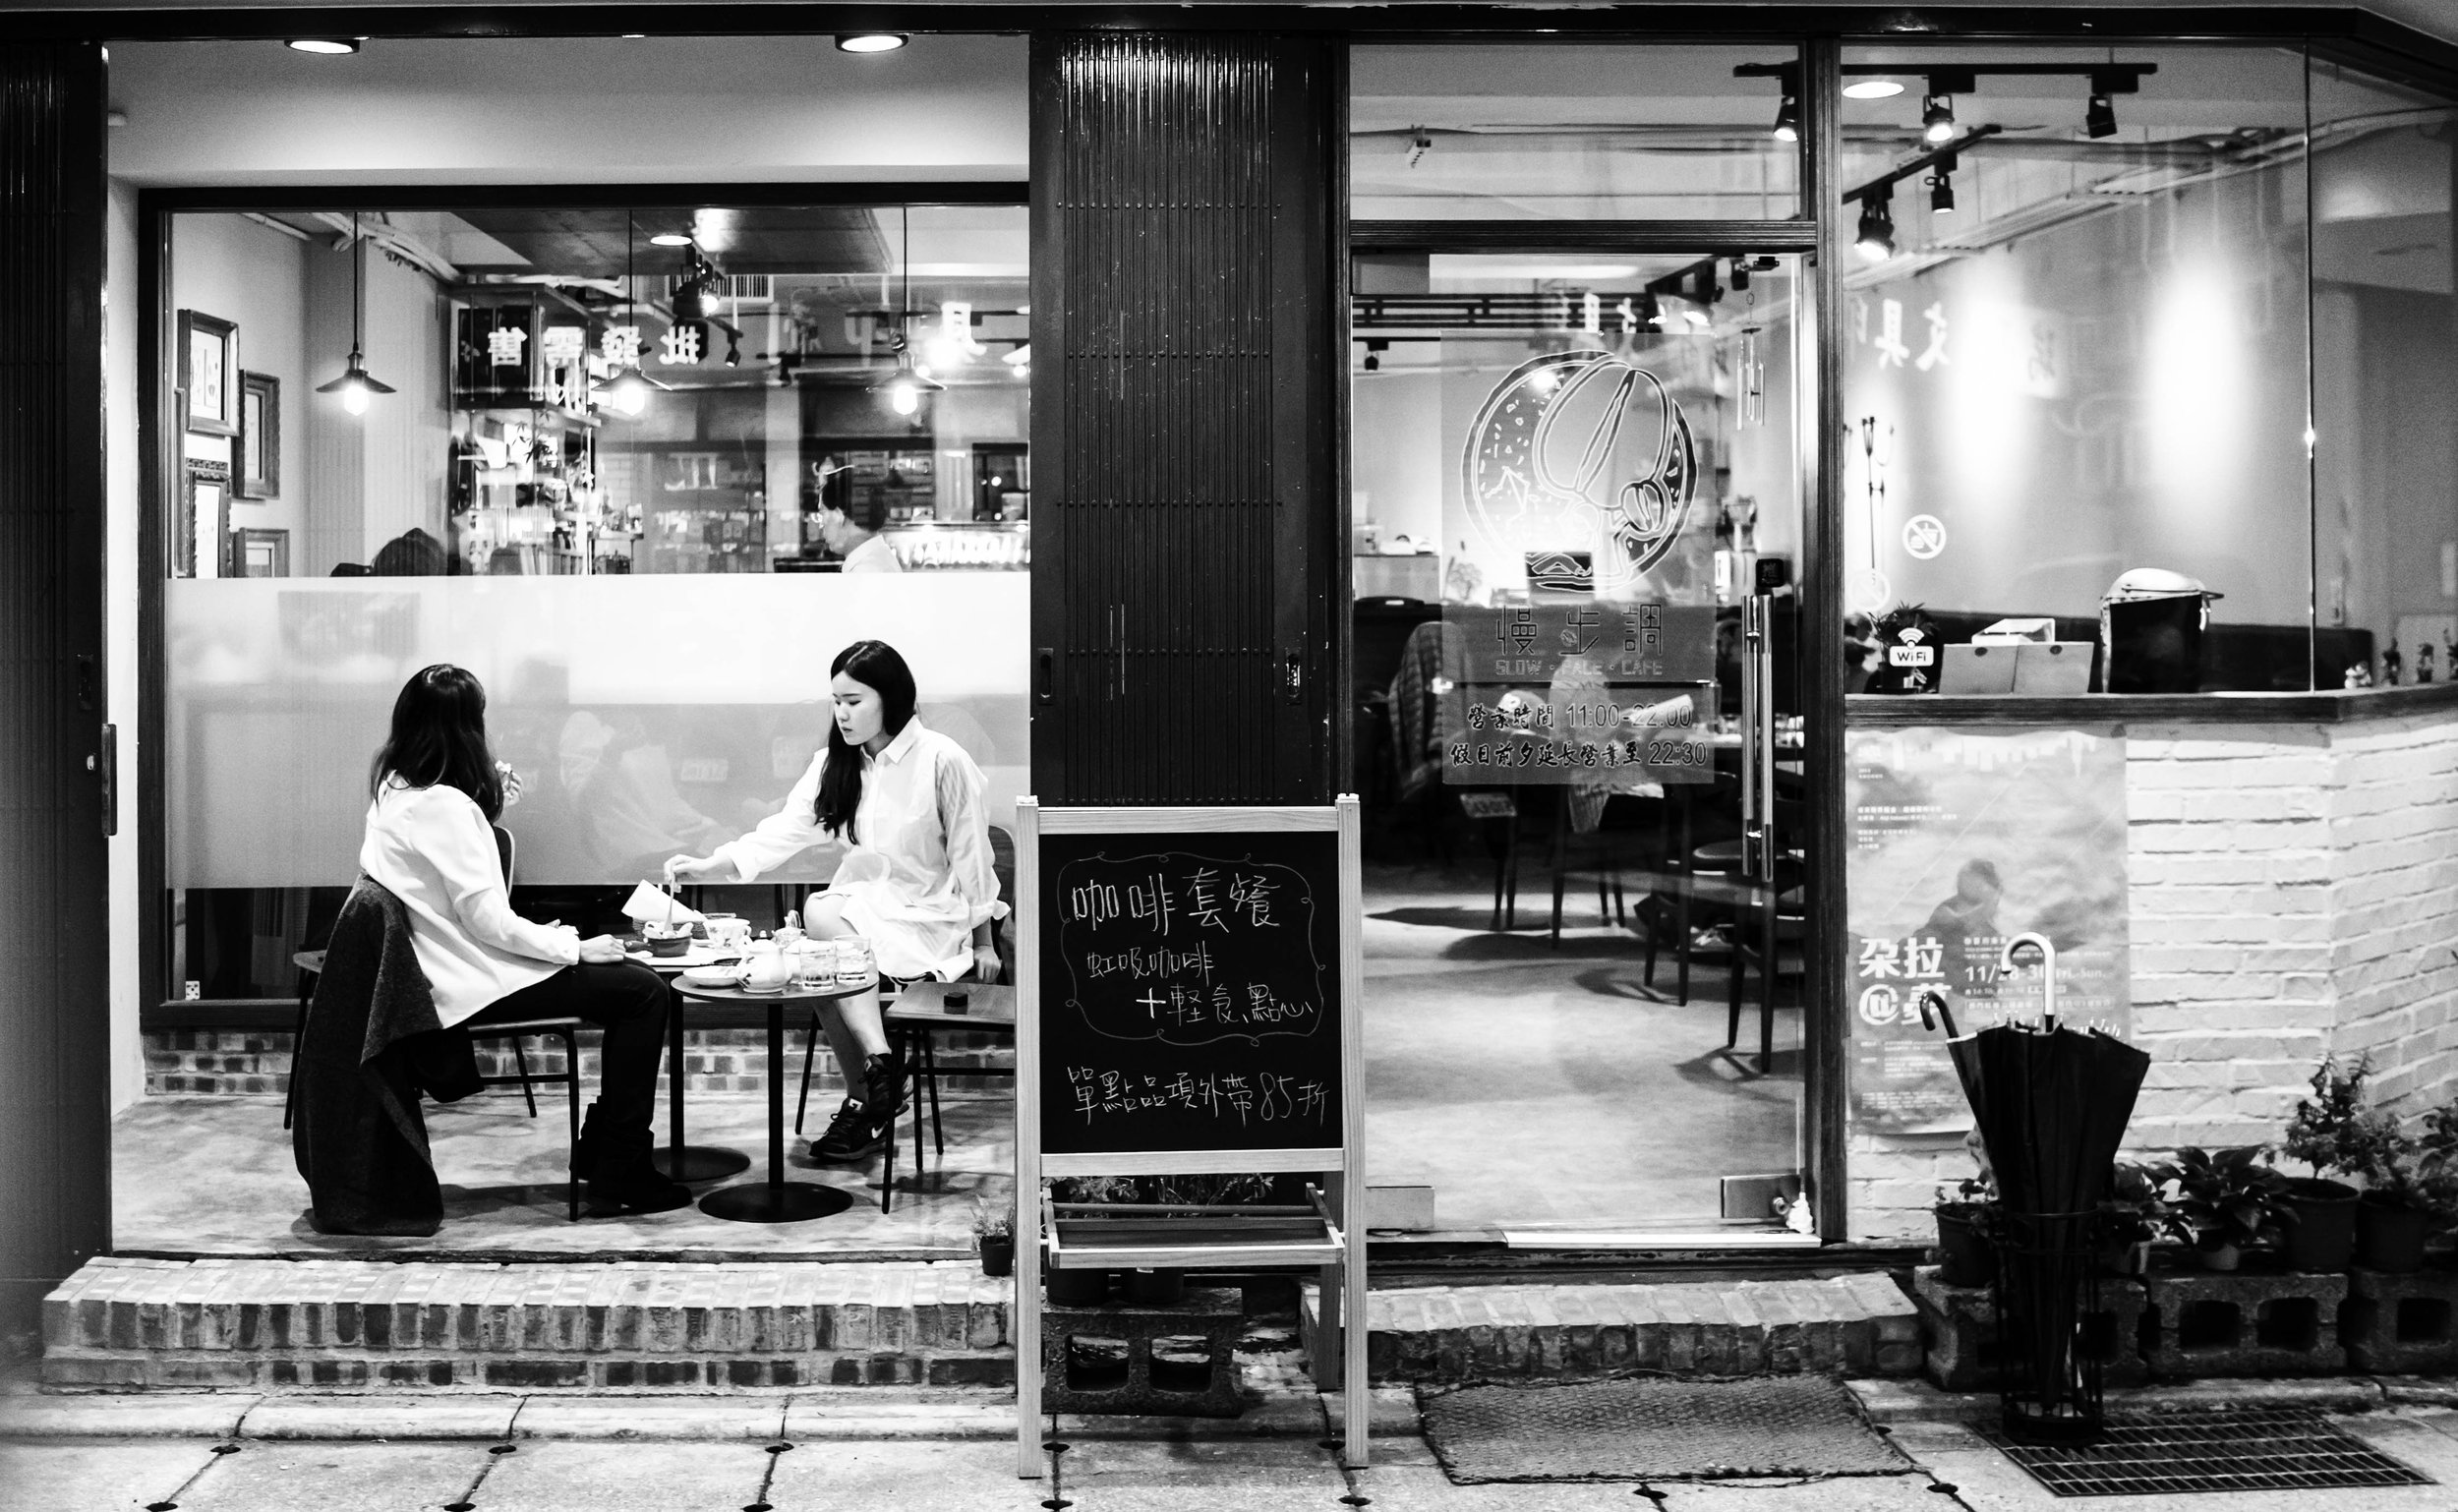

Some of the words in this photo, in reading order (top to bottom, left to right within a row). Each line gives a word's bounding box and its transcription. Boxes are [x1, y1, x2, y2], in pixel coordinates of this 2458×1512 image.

[1496, 604, 1663, 656] 慢步調
[1495, 660, 1543, 675] SLOW
[1622, 660, 1664, 675] CAFE
[1468, 703, 1554, 730] 營業時間
[1450, 741, 1643, 768] 假日前夕延長營業至
[1648, 741, 1708, 766] 22:30
[1072, 867, 1281, 936] 咖啡套餐
[1086, 940, 1215, 987] 虹吸咖啡
[1859, 936, 1946, 979] 朵拉
